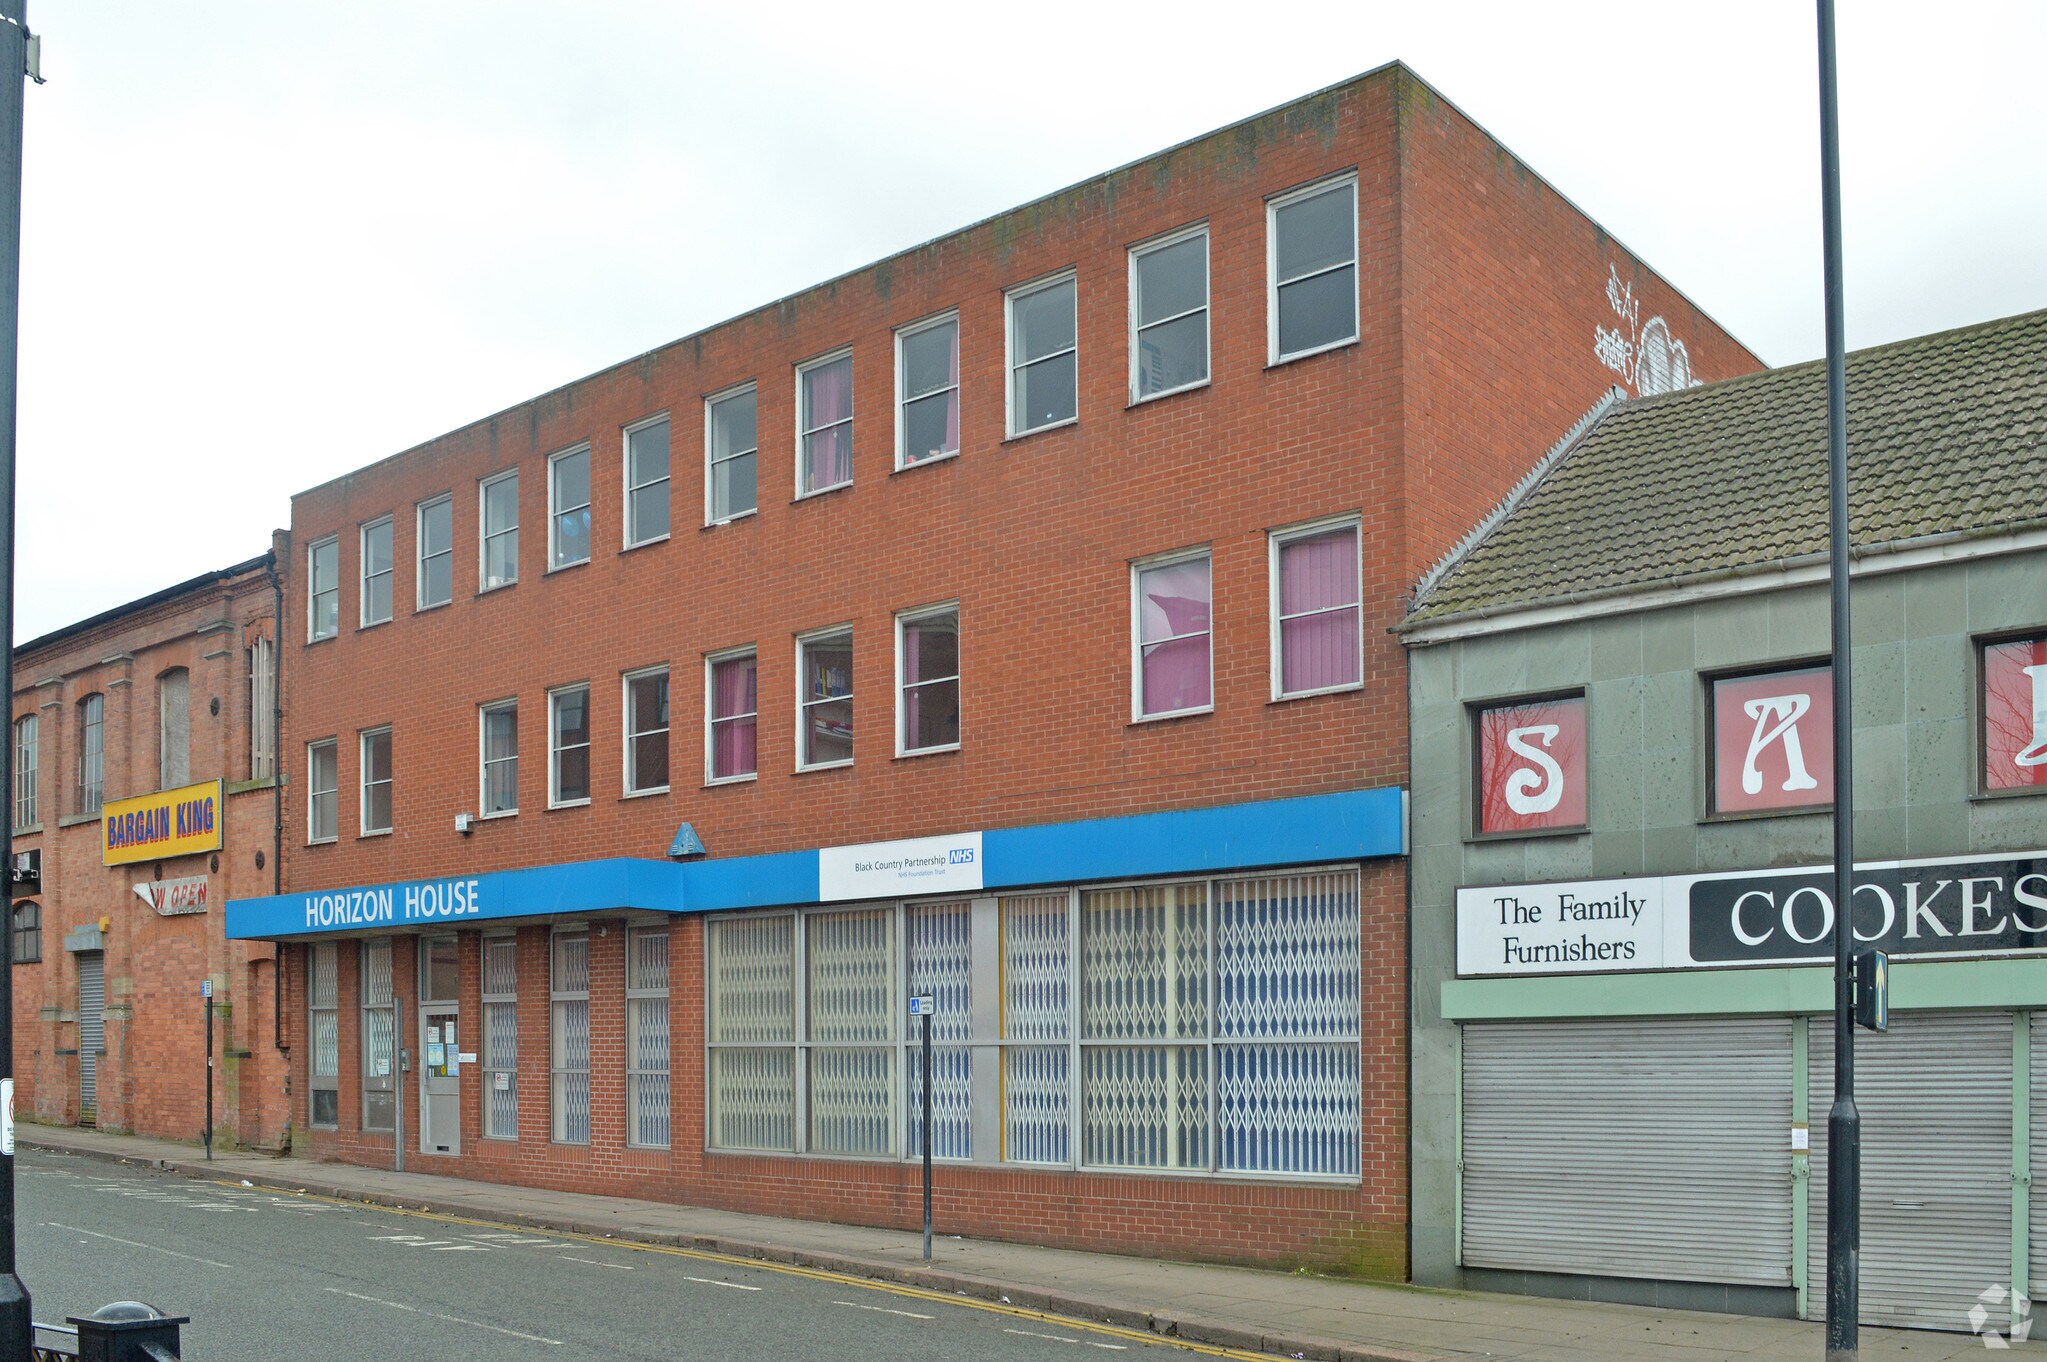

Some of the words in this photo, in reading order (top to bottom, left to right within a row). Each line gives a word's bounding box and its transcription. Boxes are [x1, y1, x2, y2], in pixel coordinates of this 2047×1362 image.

[108, 805, 170, 849] BARGAIN
[176, 797, 214, 839] KING
[855, 862, 872, 872] Black
[875, 859, 902, 870] Country
[905, 855, 946, 867] Partnership
[950, 849, 973, 863] NHS
[171, 882, 207, 908] OPEN
[306, 888, 393, 927] HORIZON
[405, 880, 479, 919] HOUSE
[1493, 896, 1542, 926] The
[1558, 891, 1647, 927] Family
[1730, 872, 2047, 947] COOKES
[1502, 936, 1636, 965] Furnishers
